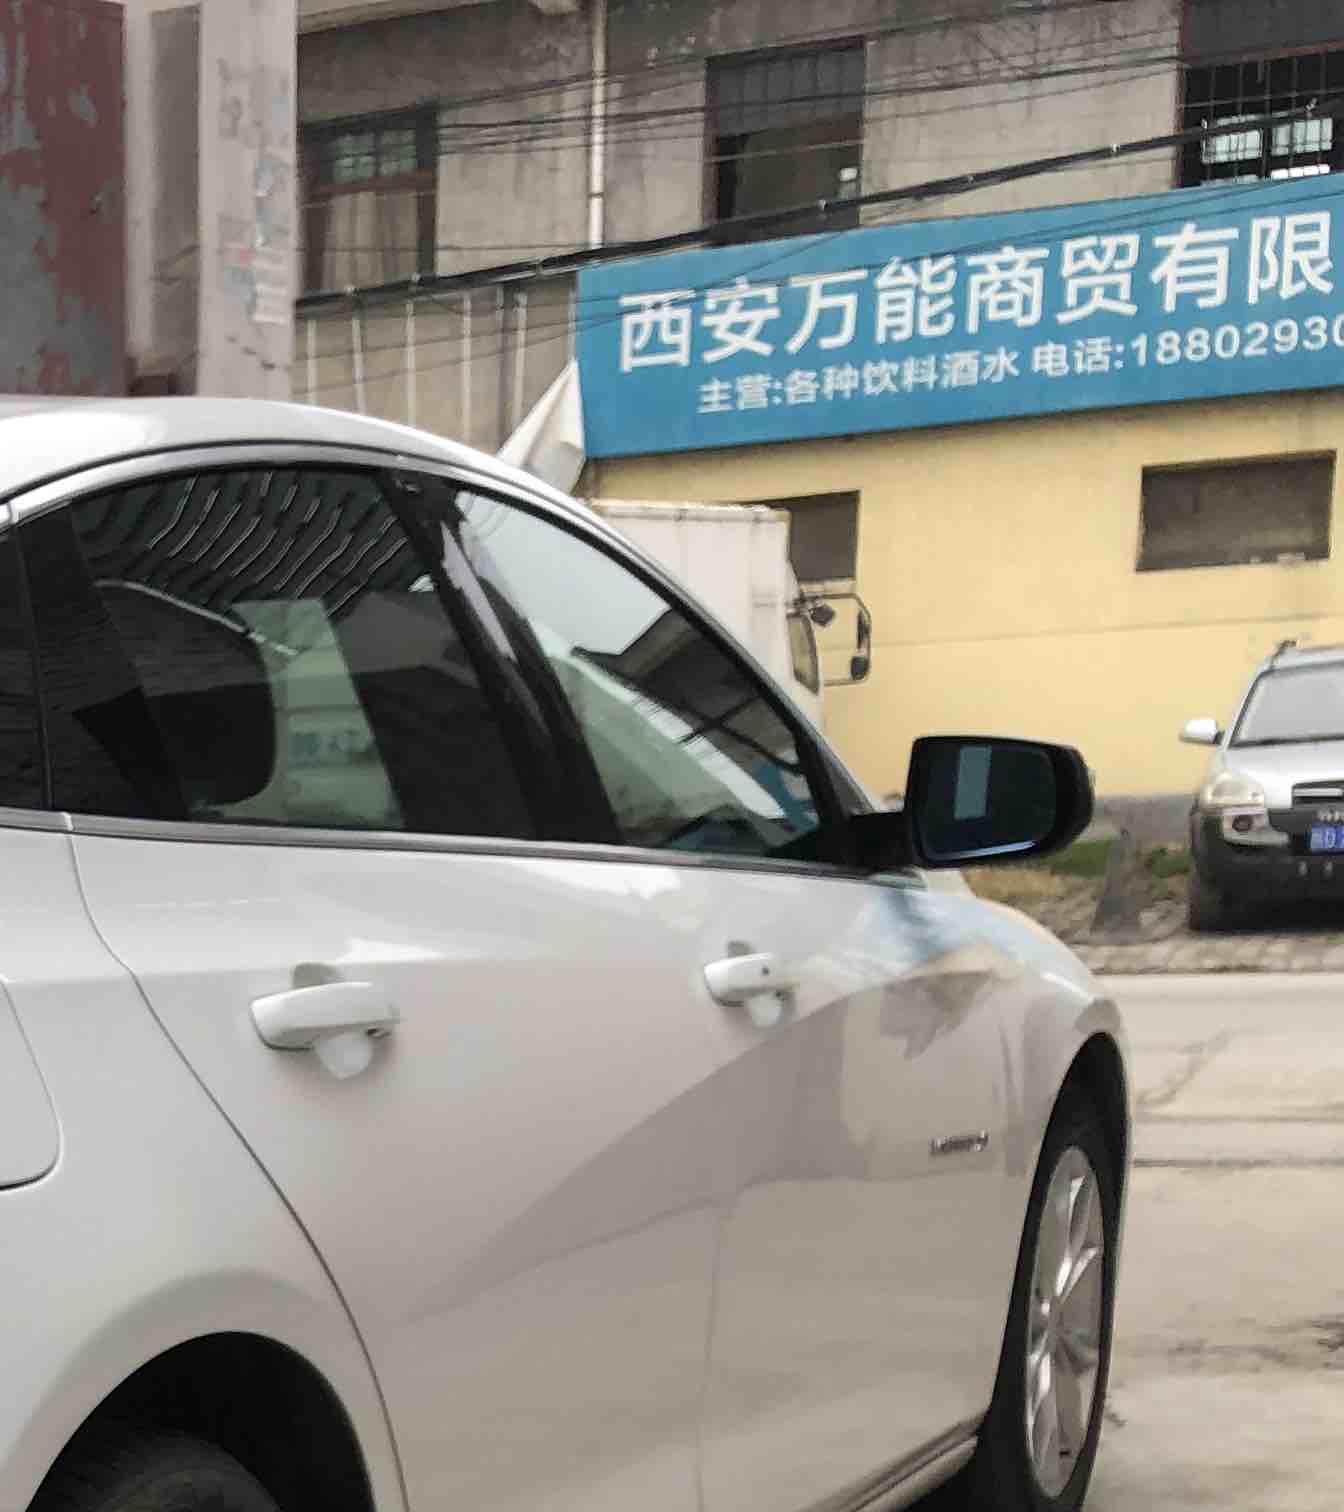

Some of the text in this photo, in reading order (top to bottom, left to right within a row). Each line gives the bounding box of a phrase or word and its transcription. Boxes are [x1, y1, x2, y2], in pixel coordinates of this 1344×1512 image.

[618, 210, 1334, 372] 西安万能商贸有限
